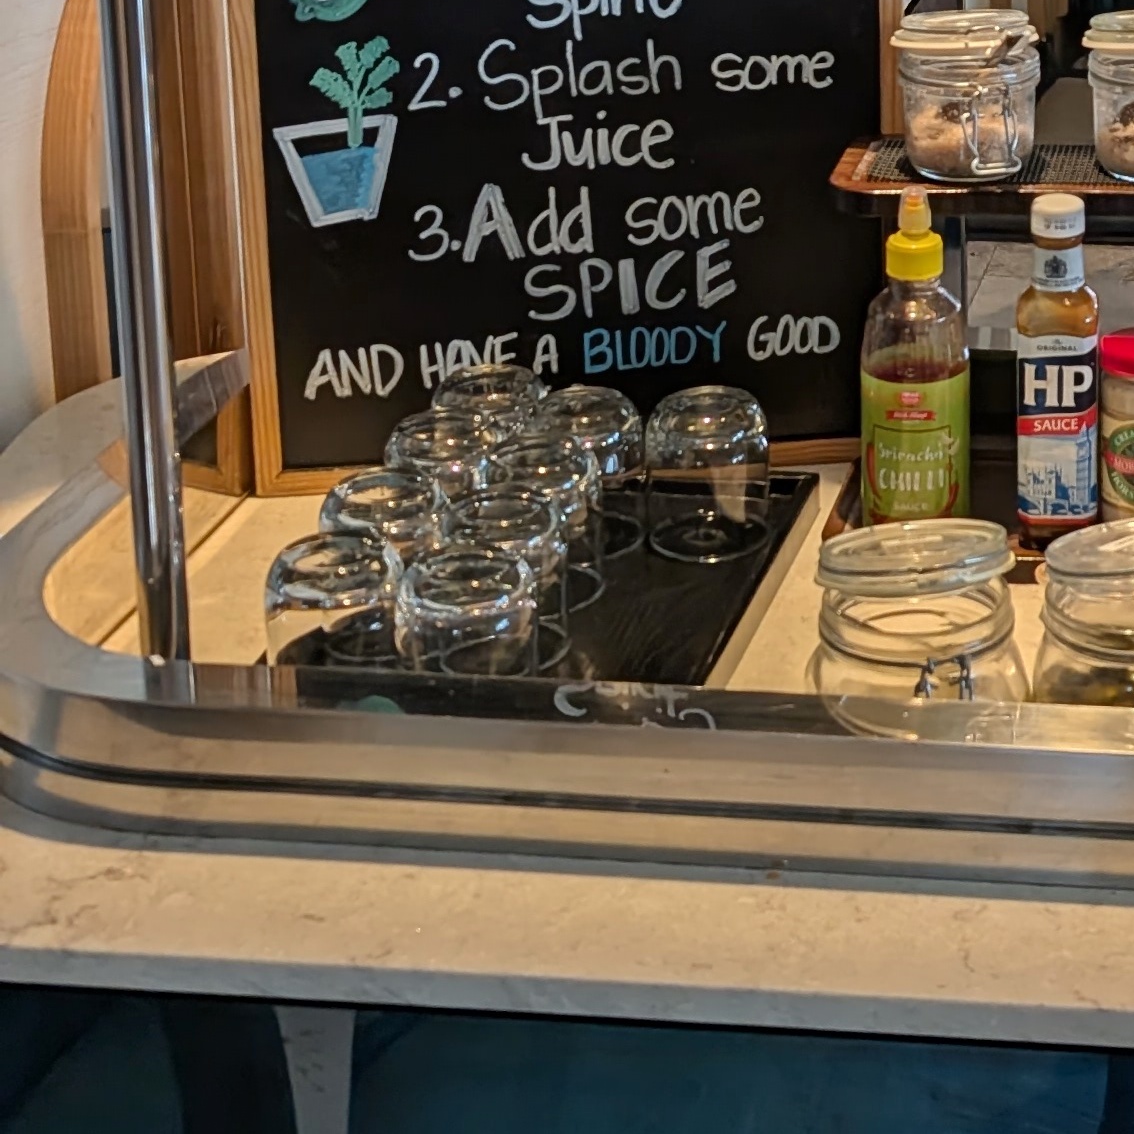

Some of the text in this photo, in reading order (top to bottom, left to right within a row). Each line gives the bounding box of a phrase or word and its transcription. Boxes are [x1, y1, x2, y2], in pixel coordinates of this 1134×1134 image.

[407, 37, 835, 122] 2. Splash some
[522, 115, 674, 171] Juice
[625, 186, 764, 243] some
[524, 238, 737, 320] SPICE
[304, 343, 405, 401] AND
[532, 333, 559, 375] A
[582, 320, 728, 373] BLOODY
[746, 313, 839, 360] GOOD
[1023, 363, 1093, 407] HP
[1033, 418, 1079, 433] SAUCE
